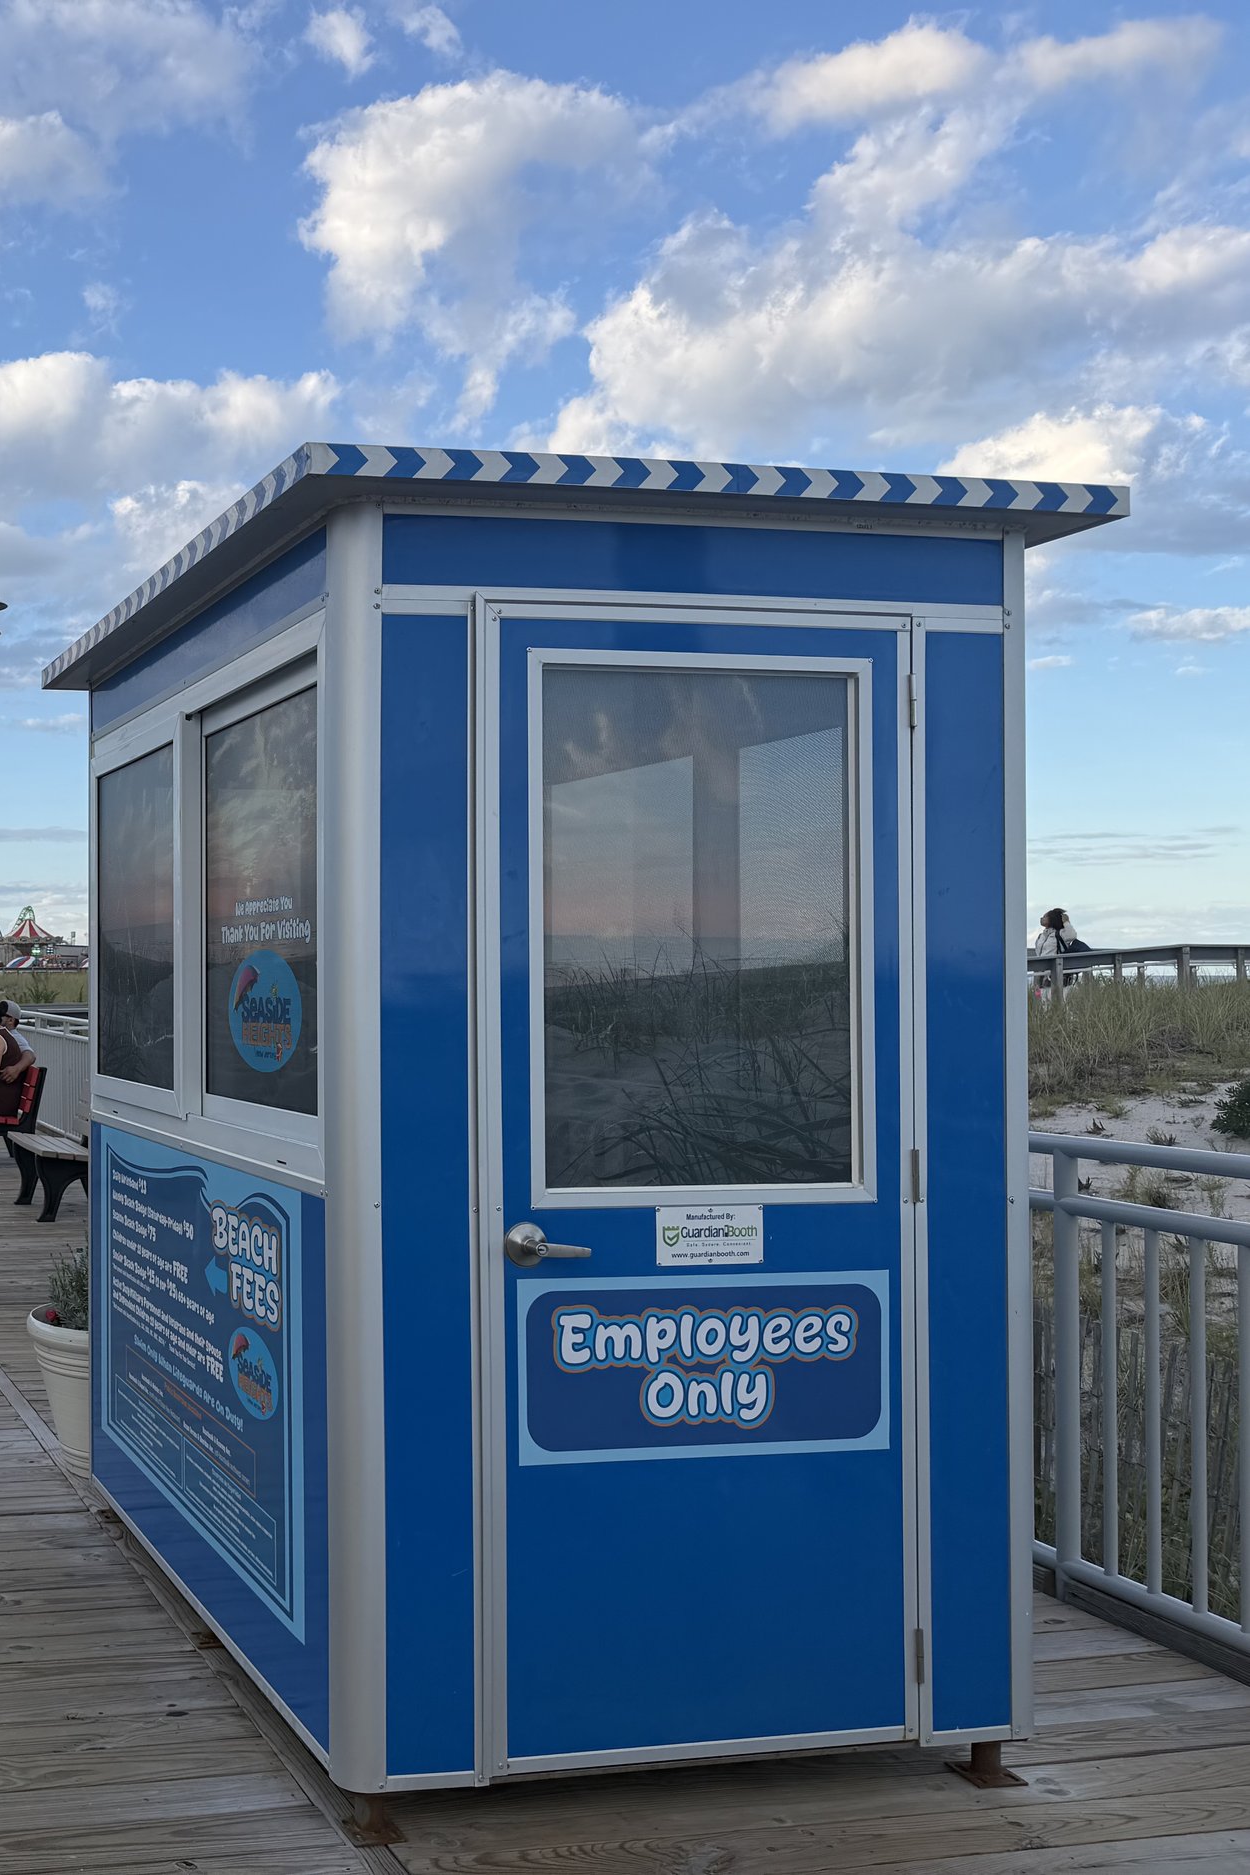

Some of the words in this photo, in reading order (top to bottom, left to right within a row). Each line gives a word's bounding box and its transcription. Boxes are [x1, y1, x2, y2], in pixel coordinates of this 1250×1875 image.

[235, 901, 244, 917] We
[280, 896, 293, 911] You
[221, 925, 243, 945] Thank
[244, 923, 259, 942] You
[260, 922, 275, 941] For
[277, 917, 311, 943] Visiting
[182, 1218, 194, 1242] $50
[685, 1213, 725, 1221] Manufactured
[725, 1213, 736, 1221] By:
[147, 1222, 156, 1243] $75
[212, 1207, 277, 1275] BEACH
[671, 1250, 750, 1259] www.guardianbooth.com
[172, 1258, 188, 1285] FREE
[231, 1263, 279, 1323] FEES
[185, 1295, 199, 1316] years
[205, 1307, 215, 1328] age
[559, 1313, 852, 1365] Employees
[205, 1352, 223, 1384] FREE
[172, 1363, 202, 1401] Lifeguards
[202, 1388, 215, 1409] Are
[215, 1397, 224, 1417] On
[224, 1404, 243, 1434] Duty!
[647, 1372, 768, 1421] Only
